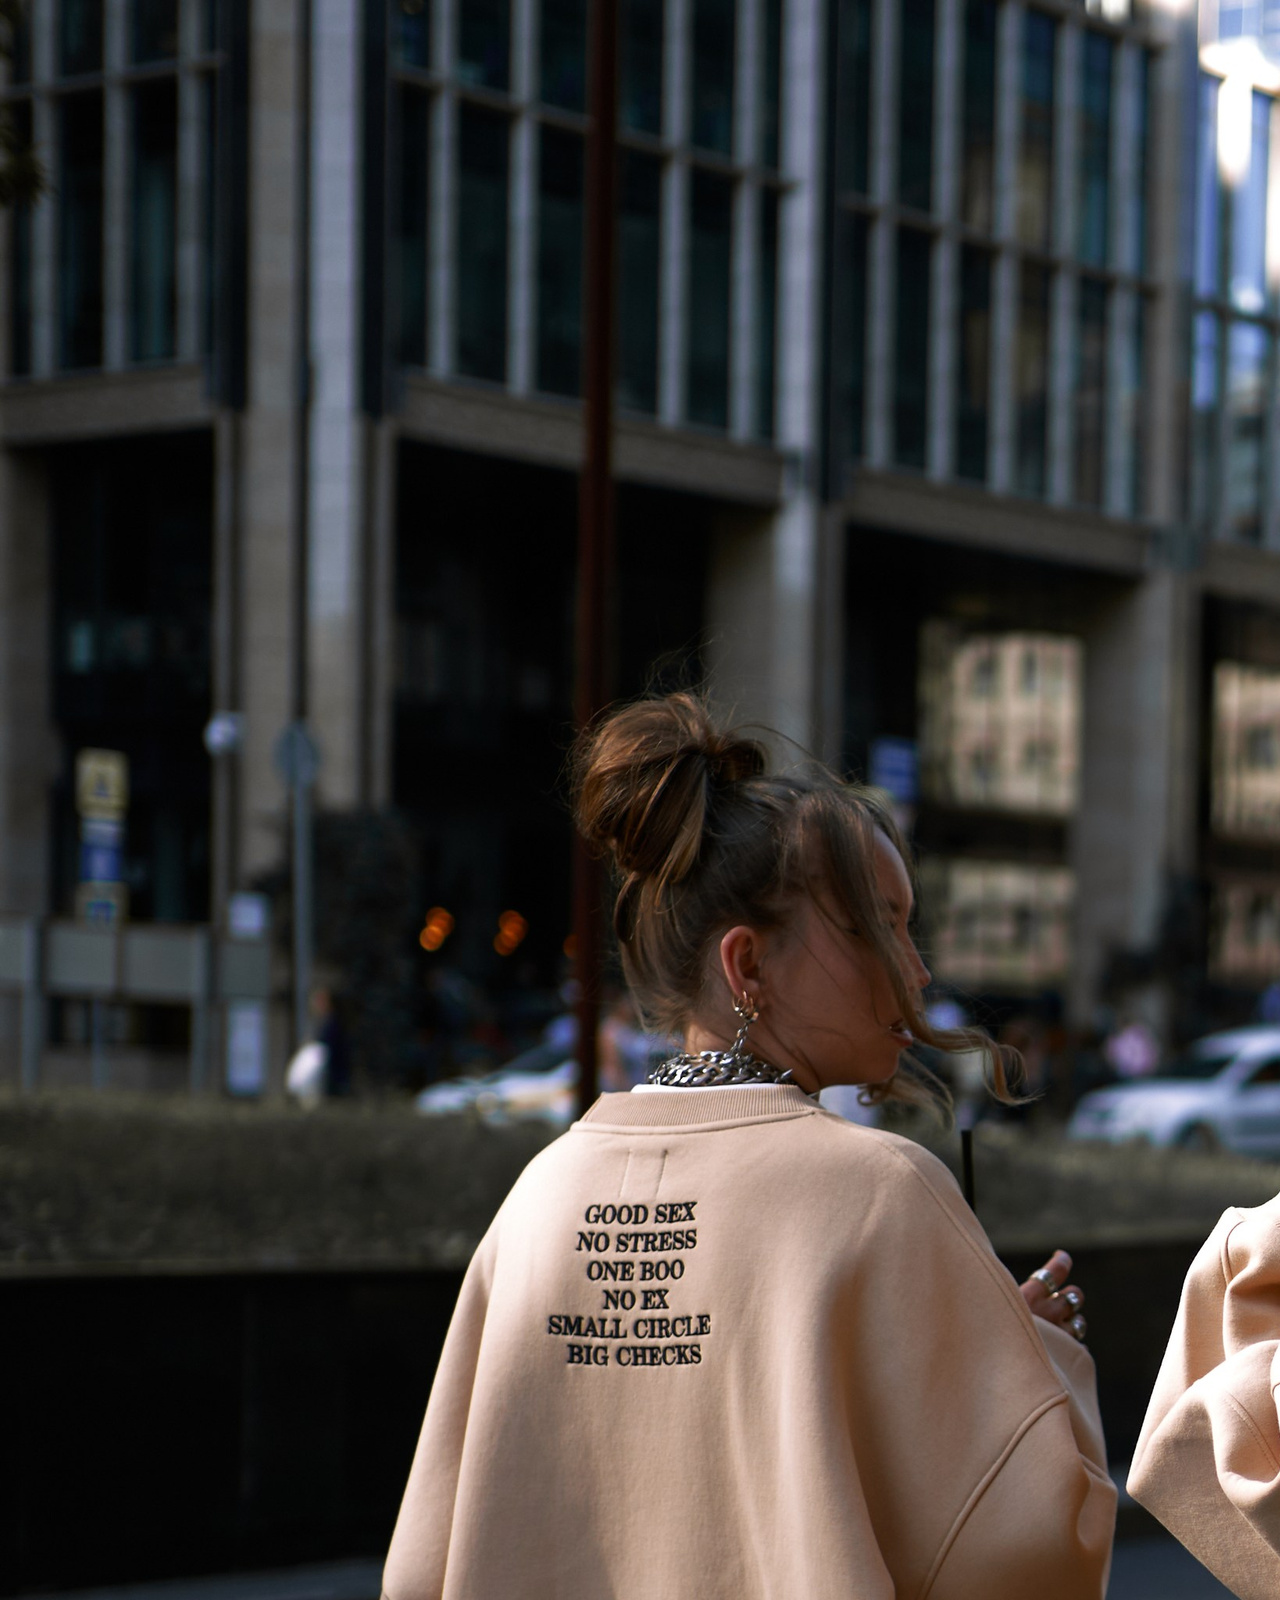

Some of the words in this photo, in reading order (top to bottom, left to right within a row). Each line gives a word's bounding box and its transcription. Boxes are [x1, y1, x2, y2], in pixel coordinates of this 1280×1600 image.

[585, 1204, 649, 1225] GOOD
[654, 1201, 698, 1223] SEX
[575, 1231, 610, 1252] NO
[615, 1229, 698, 1252] STRESS
[586, 1260, 635, 1281] ONE
[639, 1259, 685, 1281] BOO
[602, 1289, 636, 1311] NO
[640, 1288, 669, 1310] EX
[548, 1314, 627, 1338] SMALL
[633, 1314, 712, 1339] CIRCLE
[566, 1344, 609, 1366] BIG
[616, 1343, 702, 1366] CHECKS
